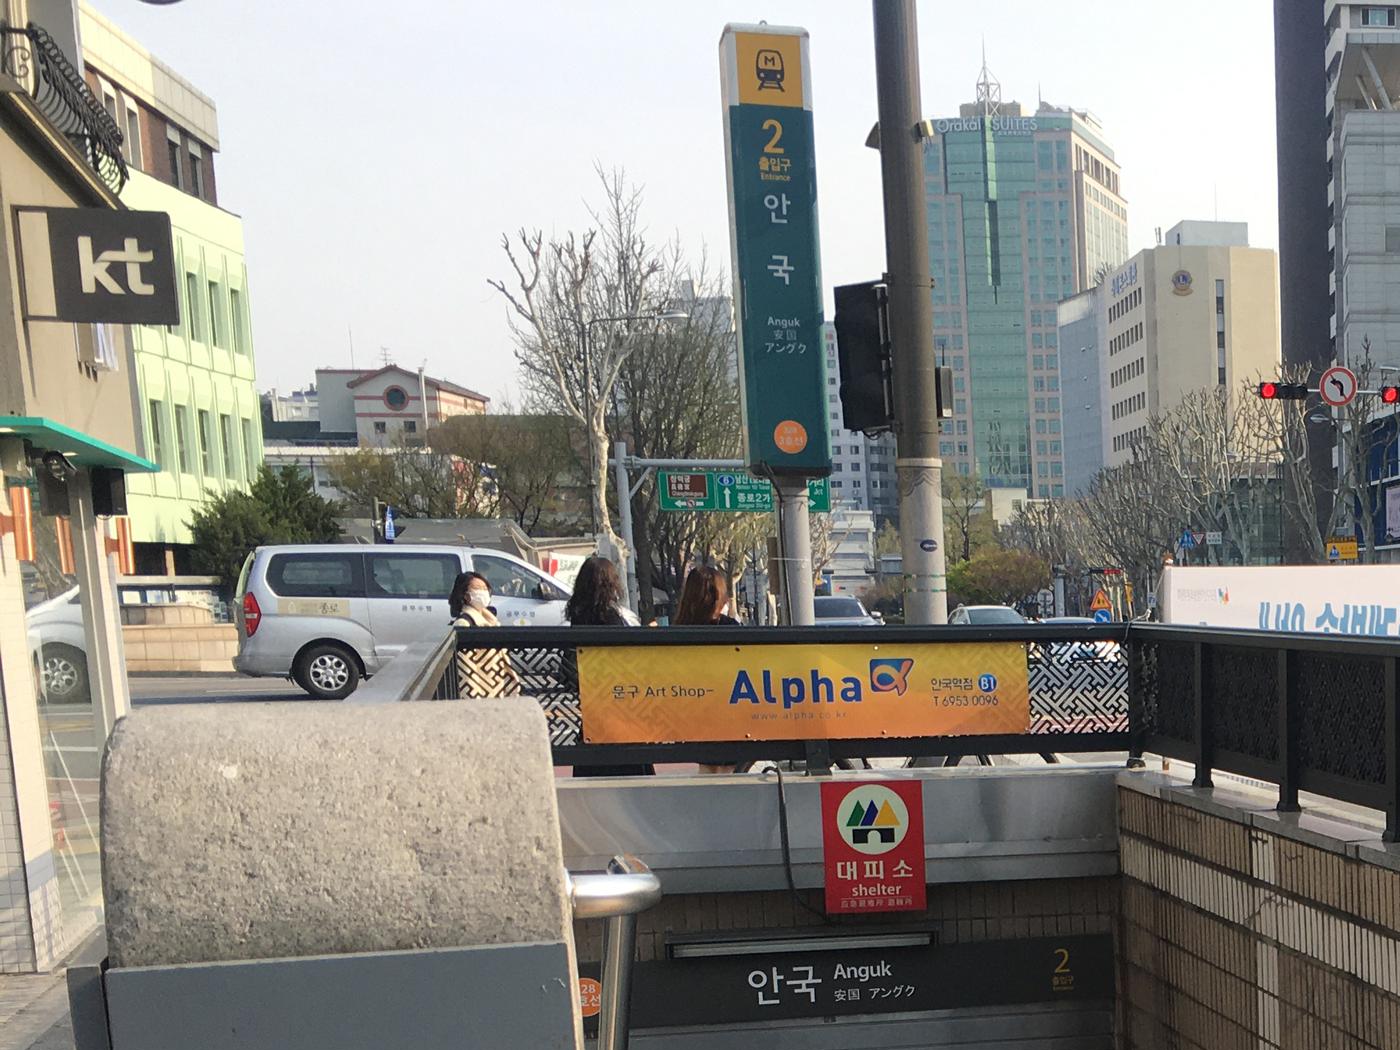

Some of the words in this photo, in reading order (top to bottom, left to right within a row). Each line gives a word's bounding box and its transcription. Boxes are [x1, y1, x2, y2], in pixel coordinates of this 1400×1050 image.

[992, 117, 1038, 131] SUITES
[762, 119, 785, 154] 2
[758, 157, 792, 172] 출입구
[760, 172, 791, 182] Entrance
[79, 235, 154, 296] kt
[767, 316, 801, 328] Anguk
[764, 342, 807, 354] アングク
[737, 493, 771, 503] 종로2가
[611, 685, 639, 699] 문구
[644, 685, 666, 698] Art
[728, 669, 863, 709] Alpha
[931, 677, 974, 692] 안국역점
[981, 677, 996, 691] B1
[933, 696, 940, 707] T
[942, 696, 969, 707] 6953
[972, 695, 999, 706] 0096
[836, 860, 913, 880] 대피소
[852, 883, 902, 897] shelter
[1054, 948, 1070, 973] 2
[834, 960, 892, 982] Anguk
[748, 966, 822, 1005] 안국
[834, 988, 860, 1001] 安国
[869, 984, 916, 999] アングク
